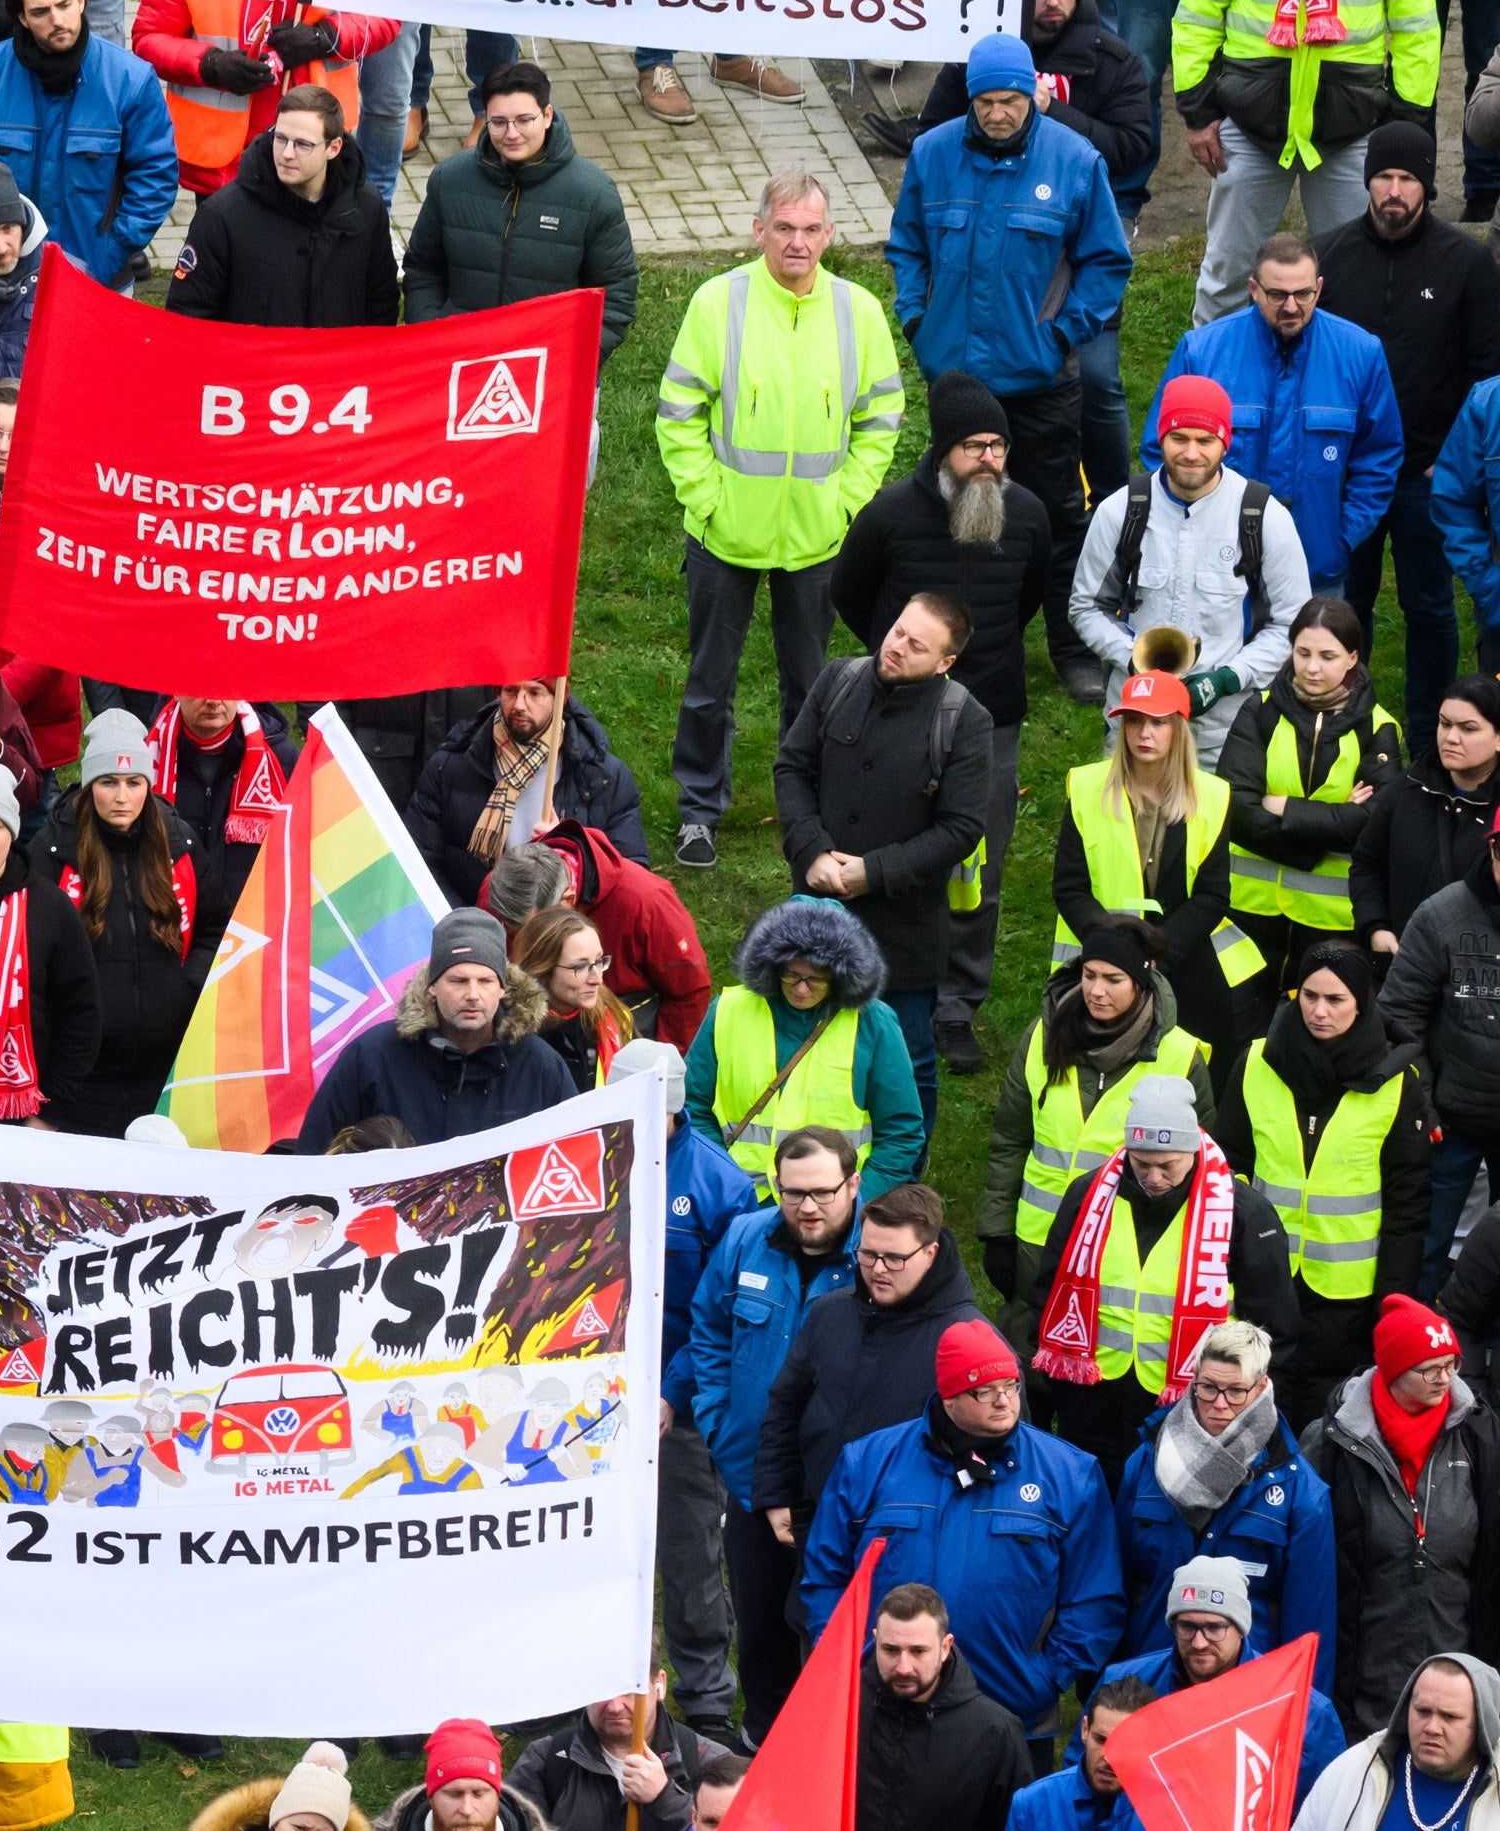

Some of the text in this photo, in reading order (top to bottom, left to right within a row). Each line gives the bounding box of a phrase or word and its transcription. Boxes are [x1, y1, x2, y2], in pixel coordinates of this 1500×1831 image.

[201, 383, 373, 436] B 9.4
[94, 462, 465, 520] WERTSCHÄTZUNG,
[36, 527, 523, 604] ZEIT FÜR EINEN ANDEREN
[136, 513, 417, 561] FAIRER LOHN,
[217, 612, 319, 645] TON!
[45, 1208, 247, 1315] JETZT
[1190, 1176, 1233, 1311] MEHR
[42, 1222, 514, 1399] REICHT'S!
[233, 1478, 336, 1498] IG METAL
[75, 1531, 161, 1568] IST
[179, 1496, 597, 1568] KAMPFBEREIT!
